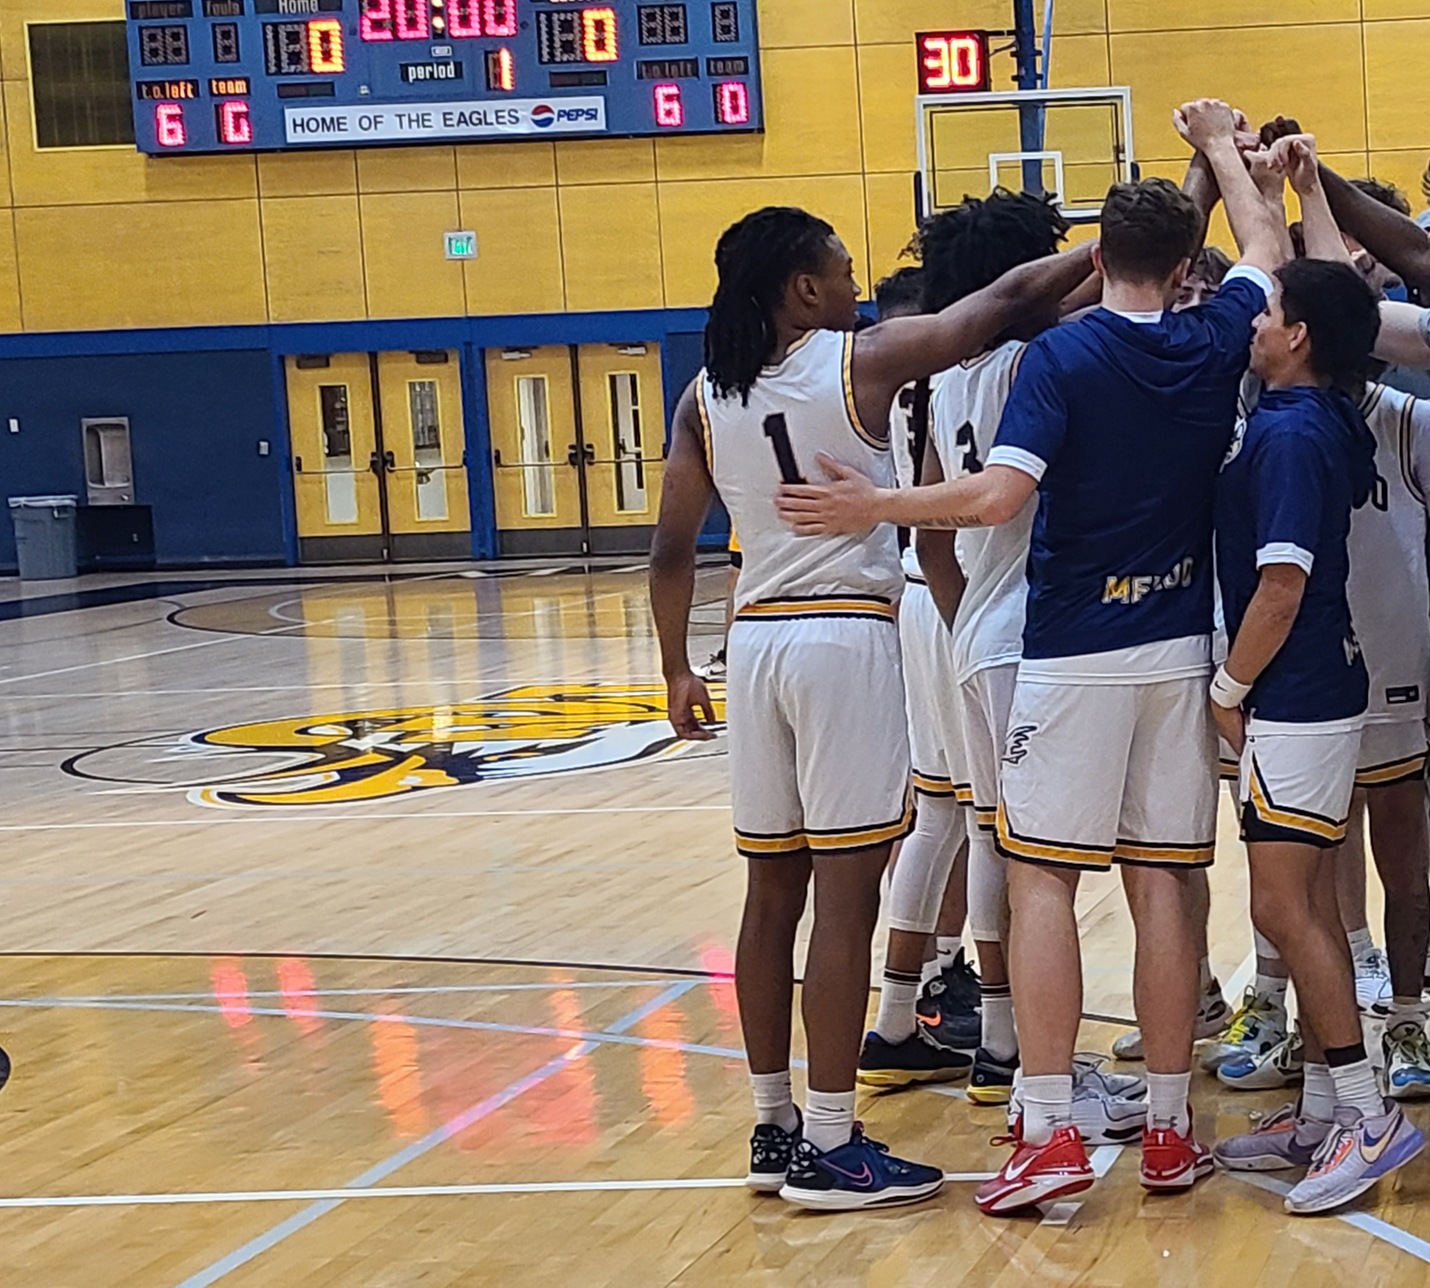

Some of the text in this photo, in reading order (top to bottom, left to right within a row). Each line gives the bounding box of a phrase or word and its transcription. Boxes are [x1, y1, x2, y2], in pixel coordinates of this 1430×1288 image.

[360, 0, 517, 41] 20:00
[582, 6, 619, 62] 0
[307, 18, 345, 73] 0
[923, 35, 980, 88] 30
[211, 79, 247, 94] team
[408, 62, 455, 83] period
[292, 108, 520, 133] HOME OF THE EAGLES
[556, 107, 599, 122] PEPSI
[654, 84, 682, 126] 6
[721, 81, 749, 124] 0
[156, 103, 186, 146] 6
[763, 412, 807, 484] 1
